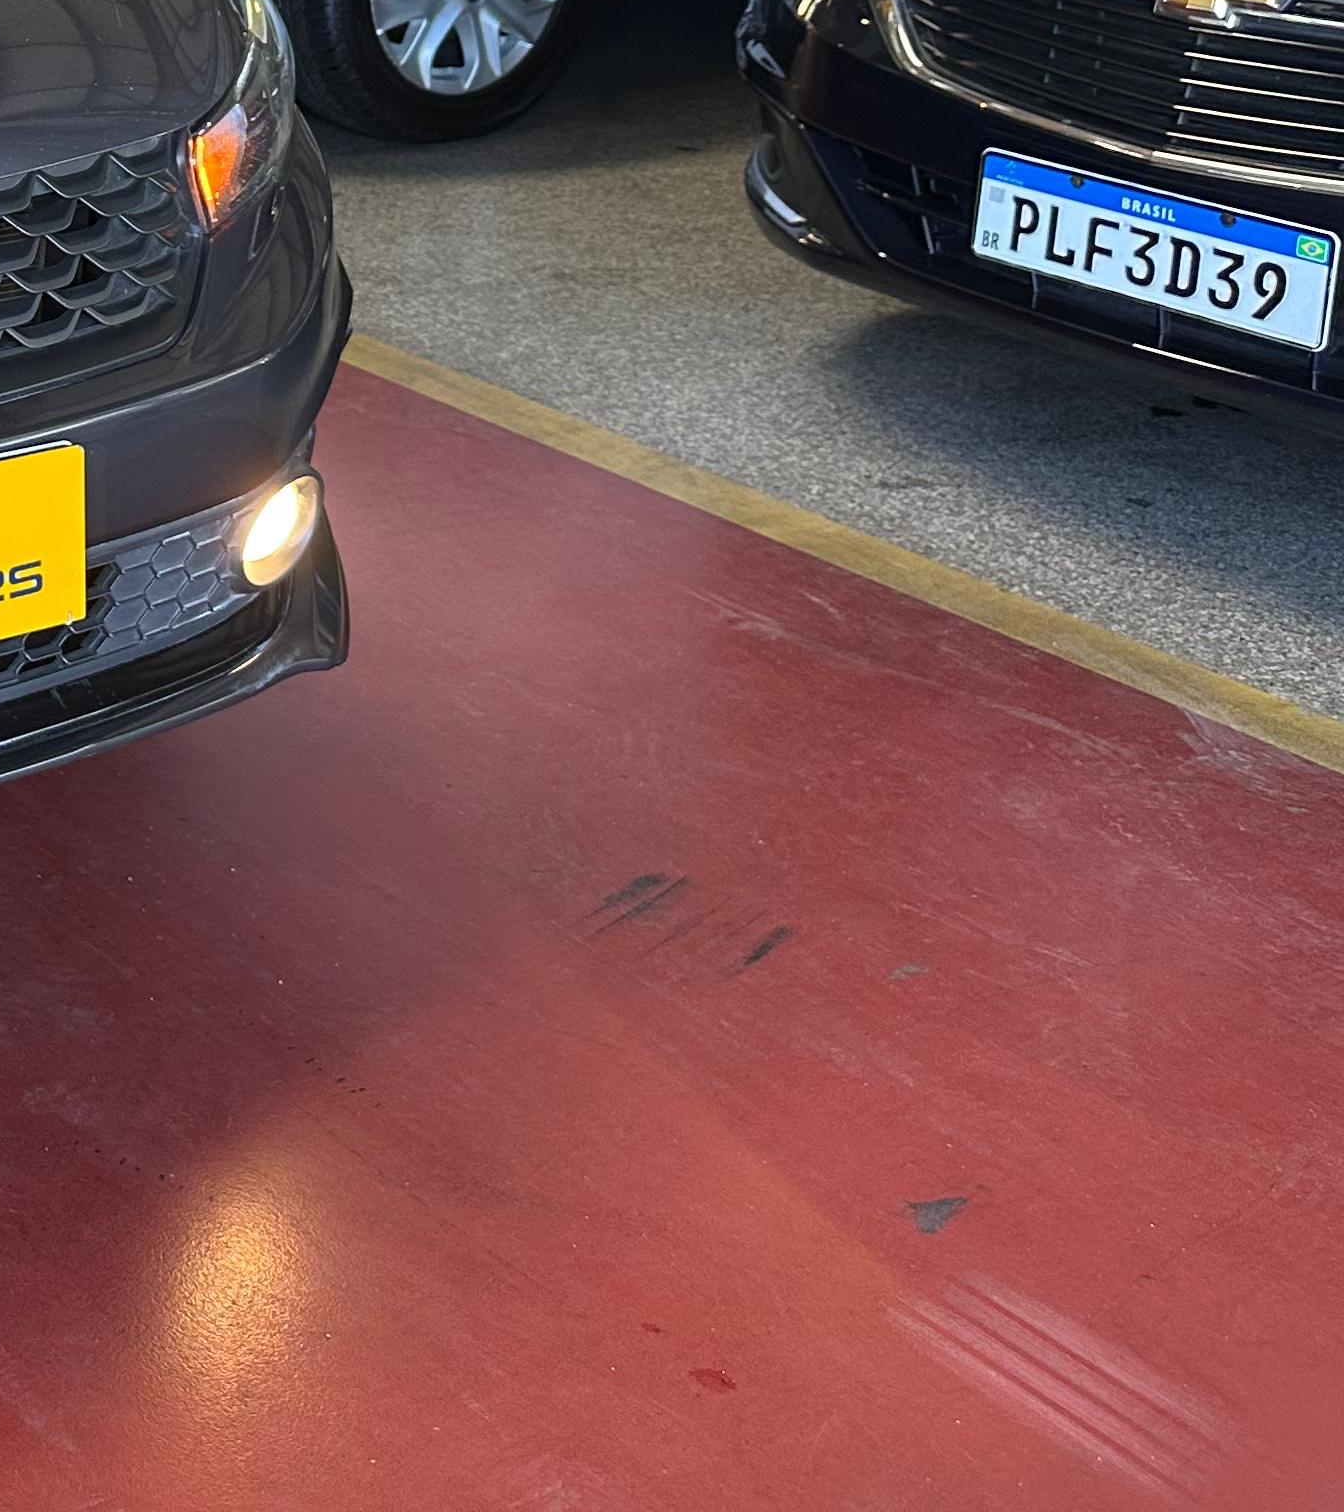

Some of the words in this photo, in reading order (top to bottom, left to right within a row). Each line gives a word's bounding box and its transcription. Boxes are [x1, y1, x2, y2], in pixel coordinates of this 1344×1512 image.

[1120, 195, 1178, 223] BRASIL
[981, 229, 1000, 251] BR
[1009, 195, 1289, 321] PLF3D39
